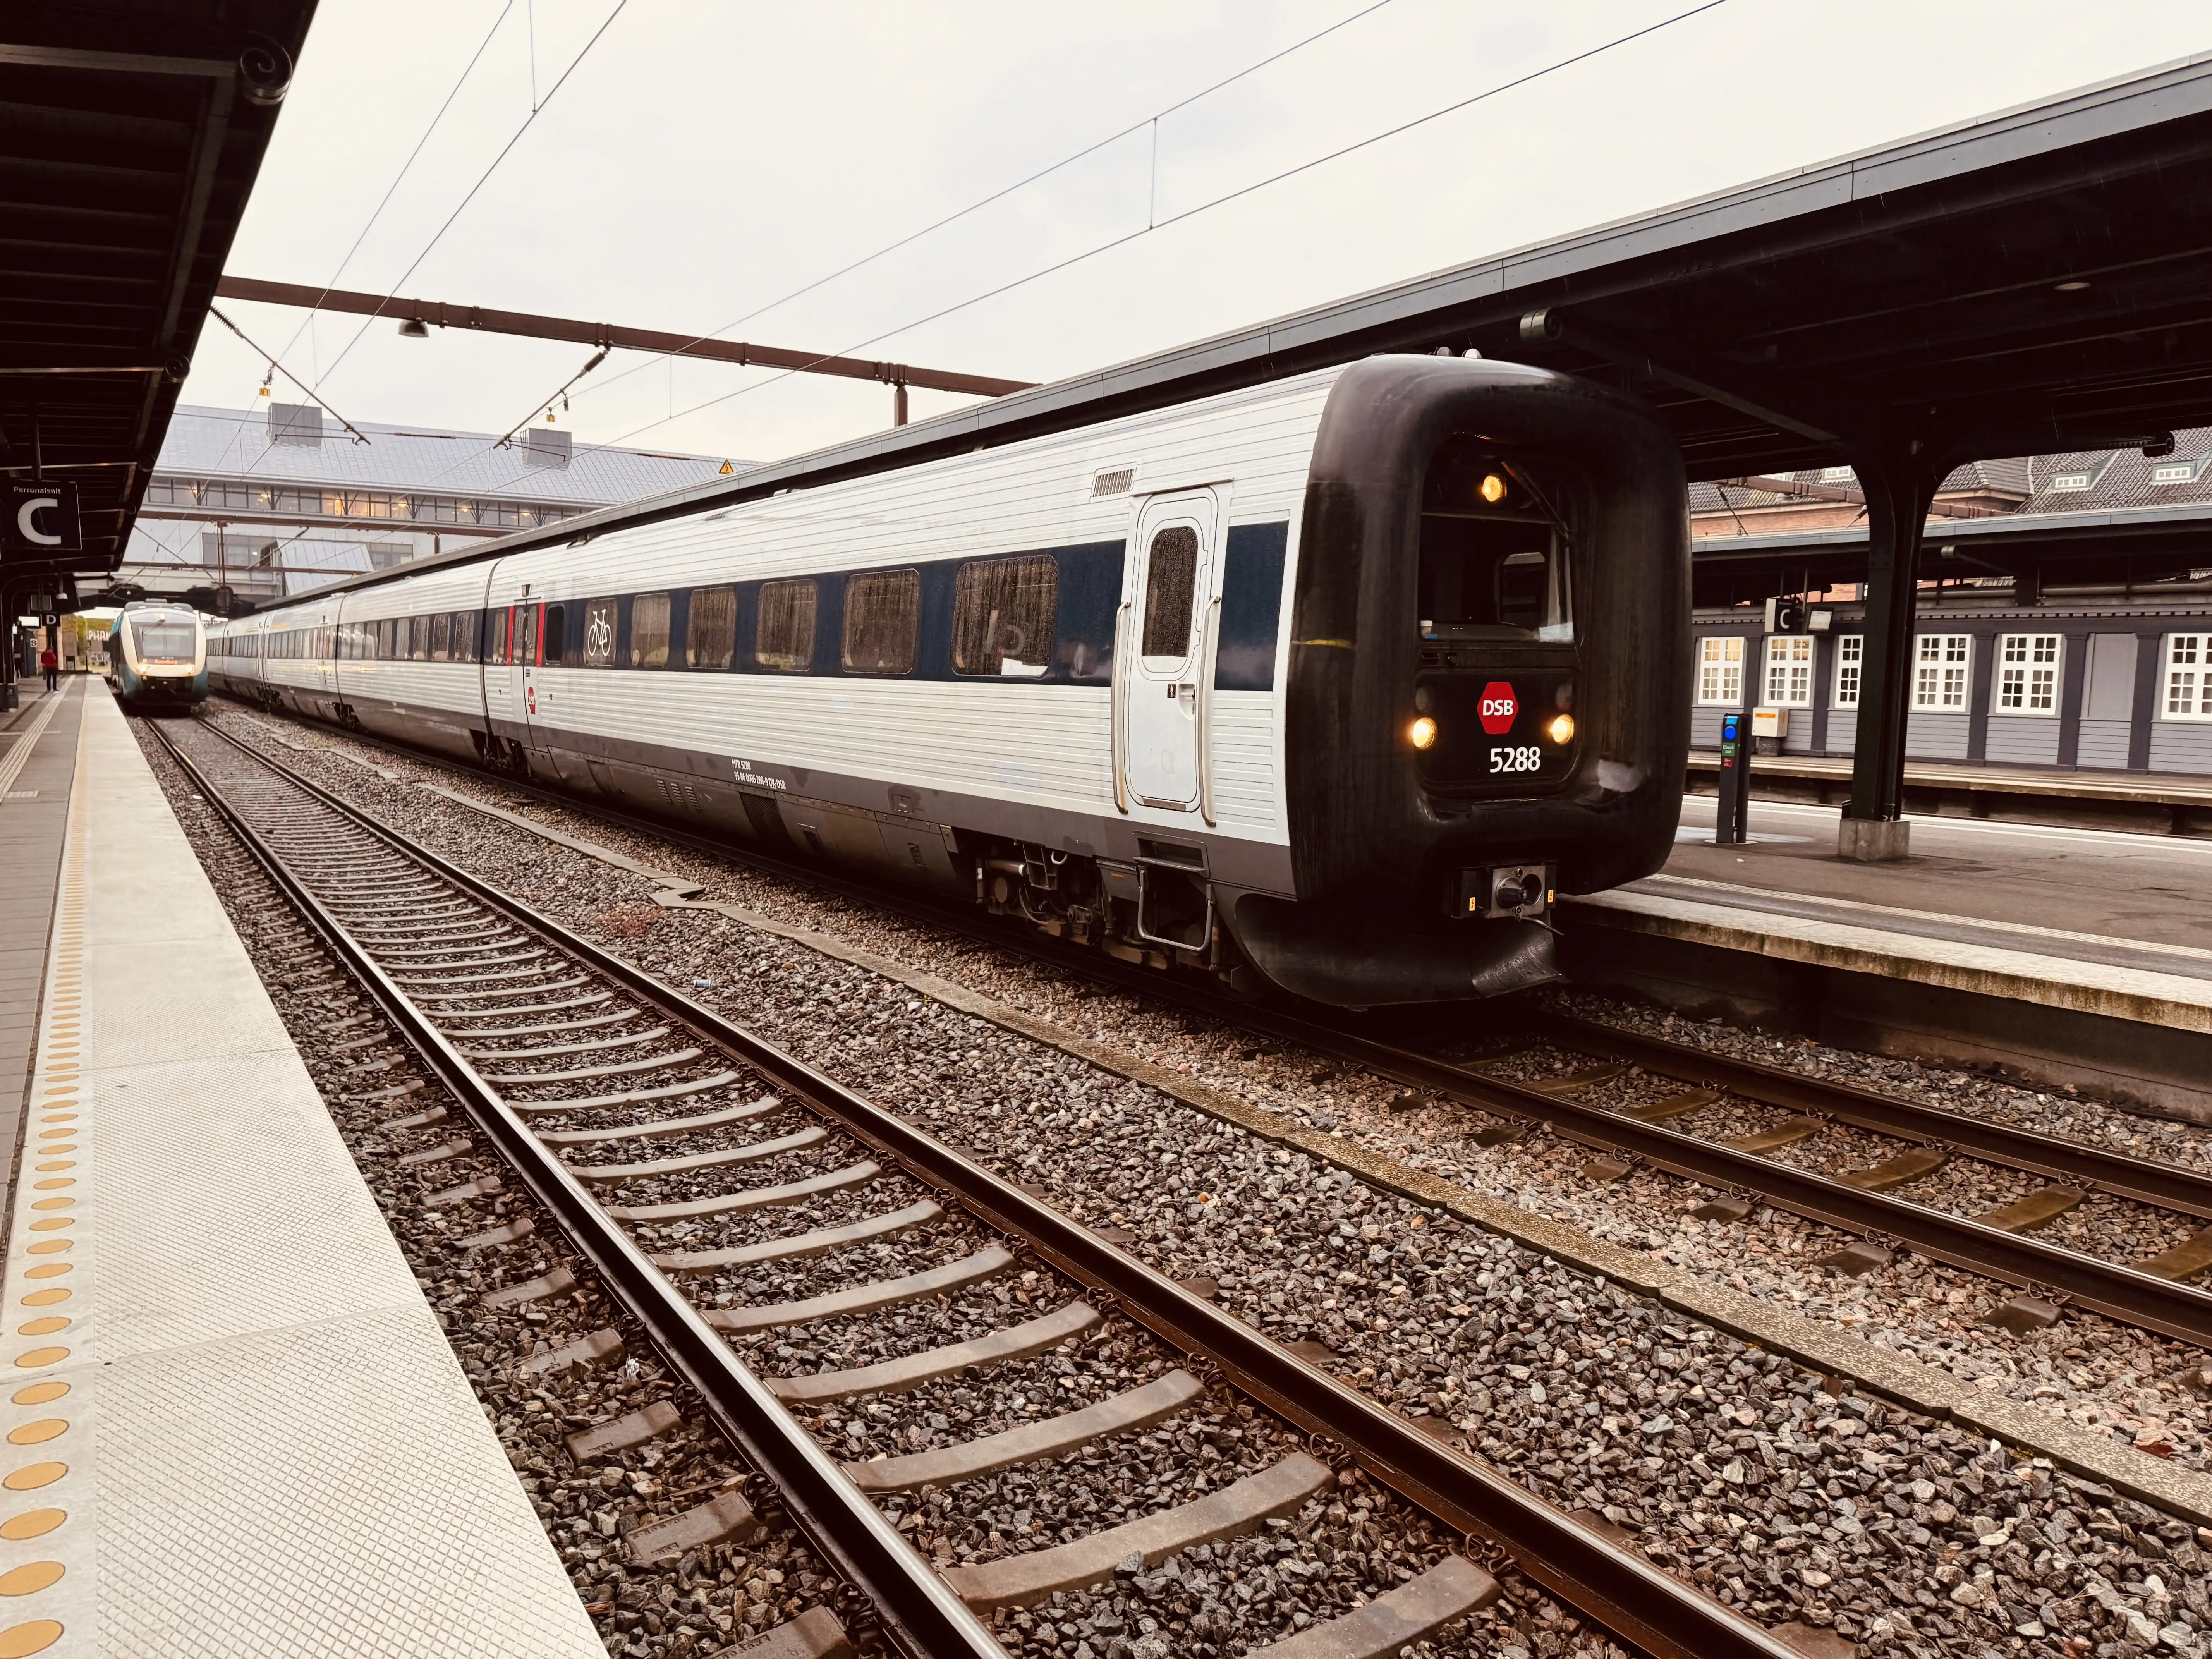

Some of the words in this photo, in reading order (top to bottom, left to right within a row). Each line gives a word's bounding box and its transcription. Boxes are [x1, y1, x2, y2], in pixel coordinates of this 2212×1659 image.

[14, 486, 61, 495] Perronafsnit
[17, 498, 62, 545] C
[46, 615, 56, 625] D
[1780, 609, 1790, 629] C
[1483, 699, 1513, 716] DSB
[732, 759, 741, 769] MFB
[741, 760, 751, 771] 5288
[1490, 746, 1540, 773] 5288
[734, 771, 740, 780] 95
[768, 777, 786, 790] DK-DSB
